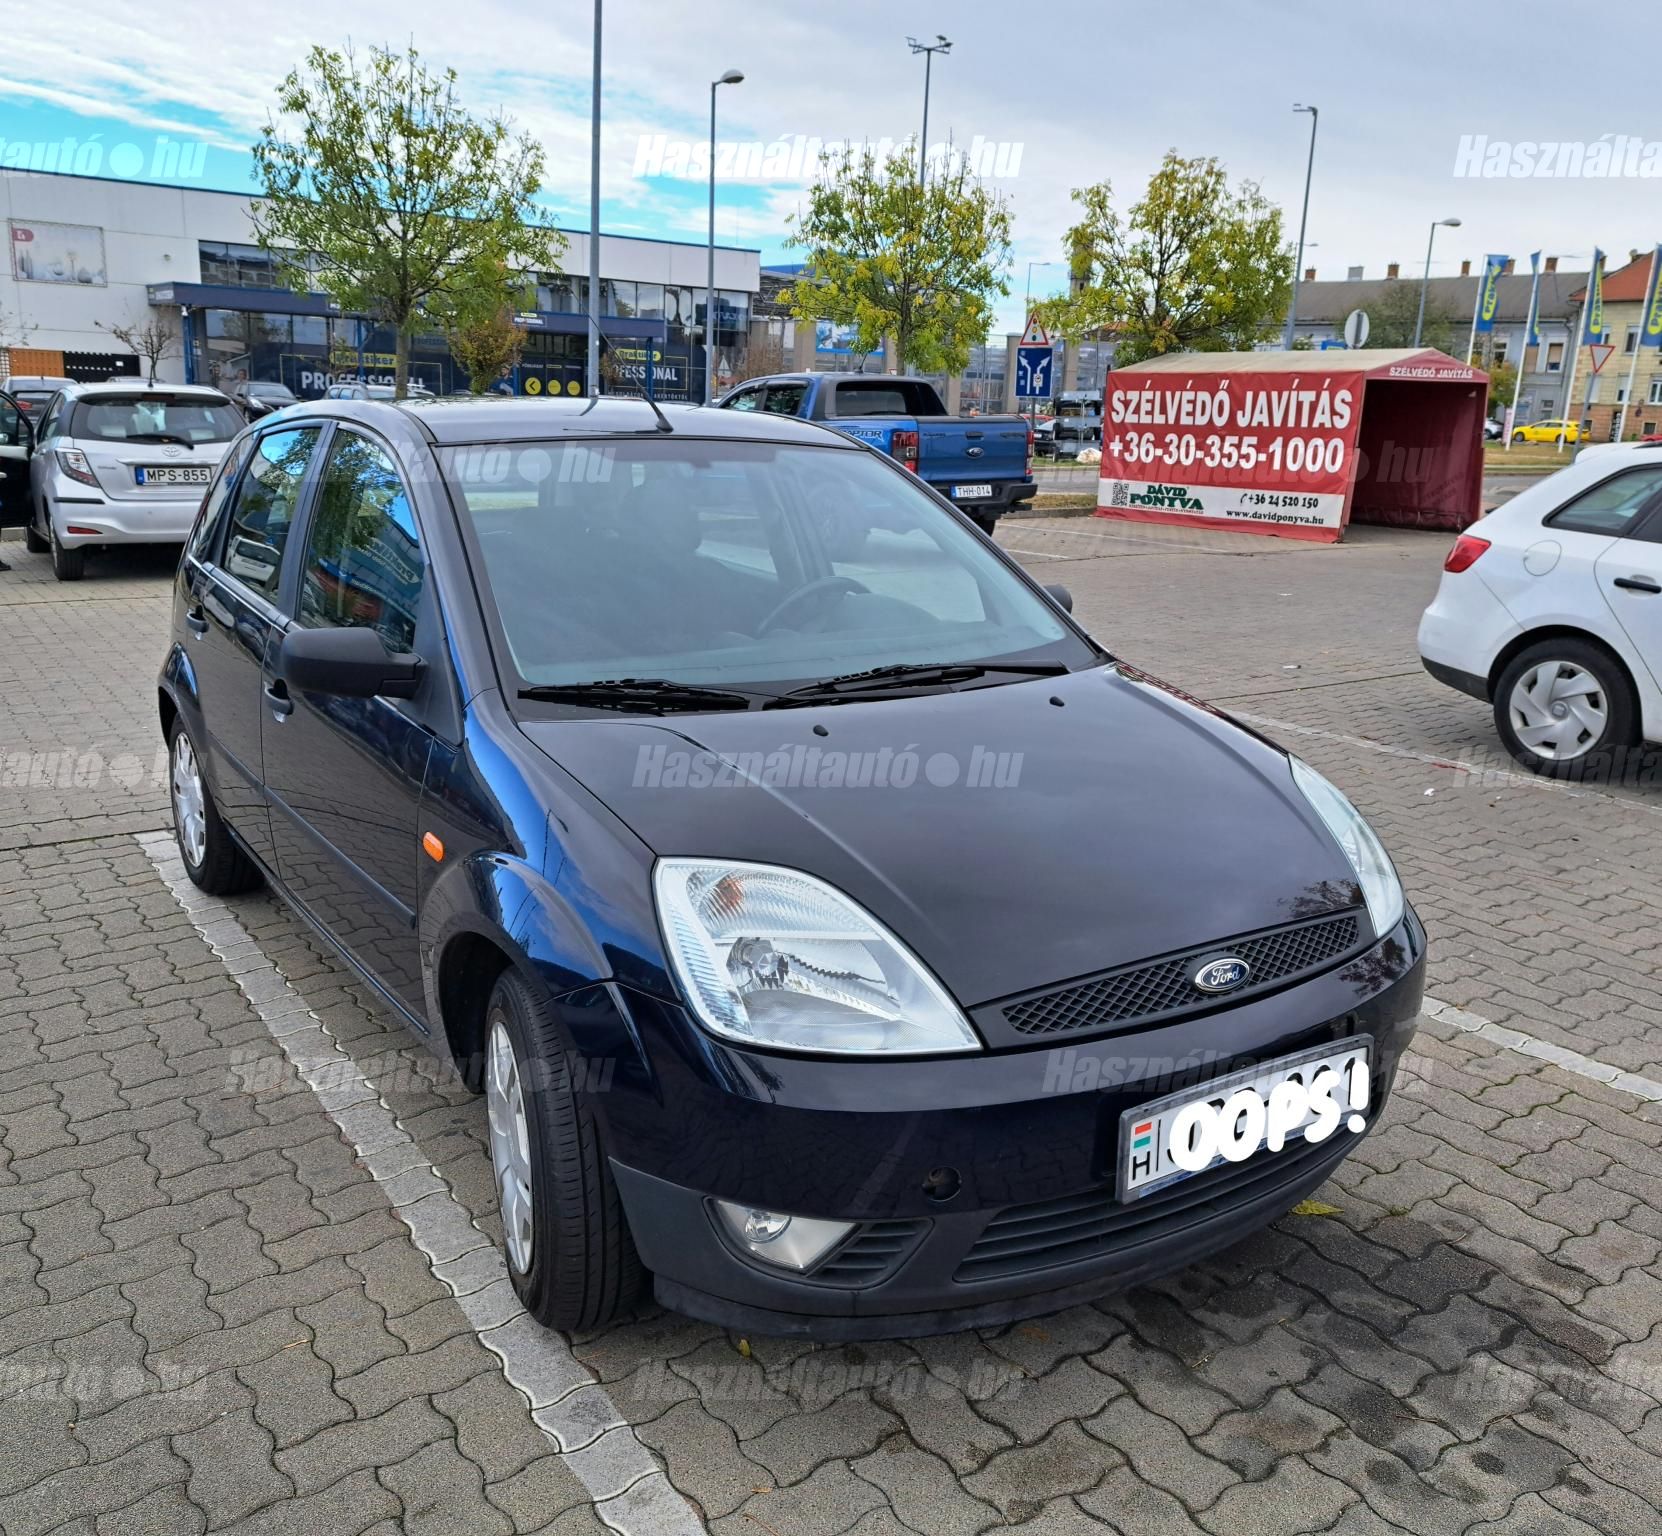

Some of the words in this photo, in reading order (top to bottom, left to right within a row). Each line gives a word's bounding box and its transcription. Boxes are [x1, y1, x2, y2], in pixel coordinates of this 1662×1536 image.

[301, 371, 424, 390] PROFESIOAL
[1437, 368, 1473, 379] JAVÍTÁS
[1111, 379, 1231, 427] SZÉLVÉDŐ
[1236, 378, 1353, 429] JAVÍTÁS
[844, 430, 884, 441] APTOR
[1109, 431, 1345, 473] +36-30-355-1000
[146, 469, 208, 481] MPS-855
[957, 486, 990, 496] THH-014
[1147, 484, 1187, 497] DÁVID
[1129, 493, 1204, 510] PONYVA
[1268, 495, 1280, 507] 24
[1282, 496, 1299, 508] 520
[1301, 497, 1319, 509] 150
[1226, 509, 1324, 525] www.davidponyva.hu
[1211, 964, 1240, 985] Ford
[1132, 1150, 1151, 1181] H
